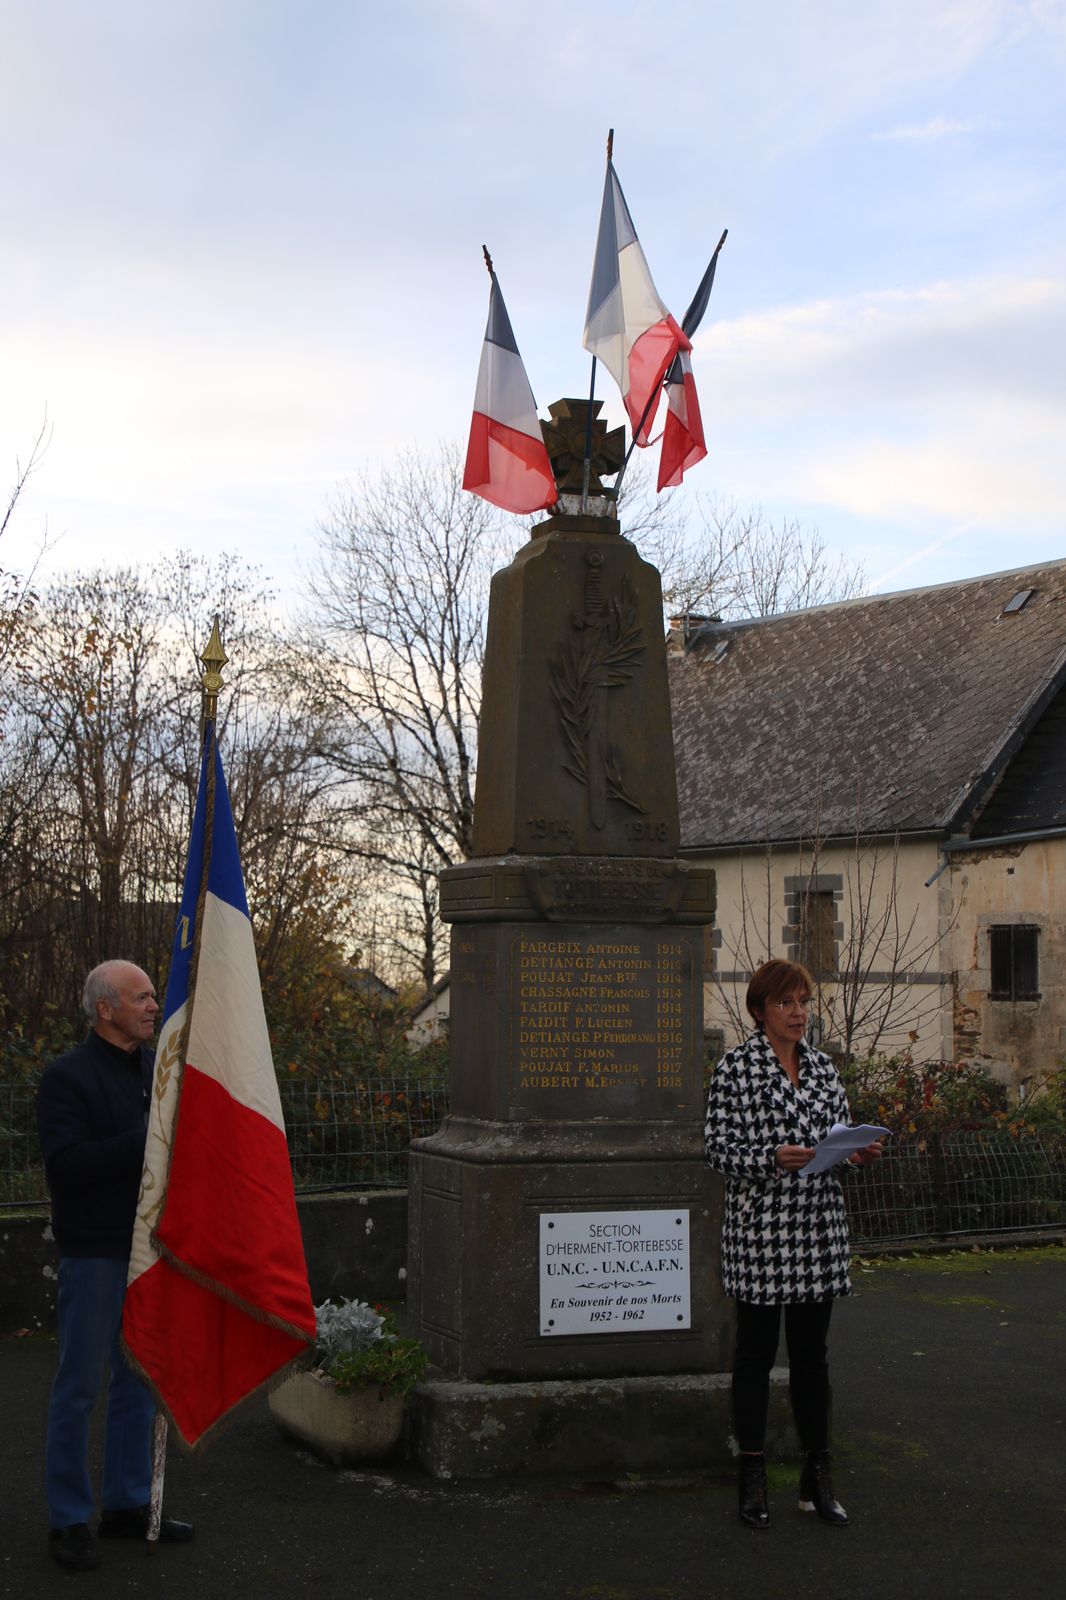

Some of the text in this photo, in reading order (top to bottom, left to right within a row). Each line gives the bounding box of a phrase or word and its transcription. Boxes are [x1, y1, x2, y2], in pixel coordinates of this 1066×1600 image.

[624, 819, 669, 842] 1918
[520, 942, 683, 955] FARGEIX ANTOINE 1914
[520, 957, 594, 969] DETIANGE
[597, 959, 651, 969] ANTONIN
[520, 971, 574, 983] POUJAT
[656, 973, 682, 984] 1914
[520, 987, 597, 998] CHASSAGNE
[656, 987, 682, 999] 1914
[520, 1002, 682, 1014] TARDIF ANTONIN 1914
[520, 1016, 568, 1028] FAIDIT
[656, 1017, 682, 1028] 1915
[520, 1032, 590, 1043] DETIANGE
[656, 1033, 683, 1043] 1916
[520, 1047, 682, 1058] VERNY SIMON 1917
[520, 1062, 572, 1073] POUJAT
[656, 1062, 682, 1073] 1917
[520, 1077, 580, 1088] AUBERT
[656, 1077, 682, 1088] 1918
[589, 1224, 641, 1238] SECTION
[546, 1239, 684, 1256] D'HERMENT-TORTEBESSE
[547, 1262, 589, 1276] U.N.C.
[602, 1259, 684, 1274] U.N.C.A.F.N.
[550, 1293, 682, 1309] En Souvenir de nos Morts
[589, 1311, 612, 1322] 1952
[622, 1309, 645, 1321] 1962
